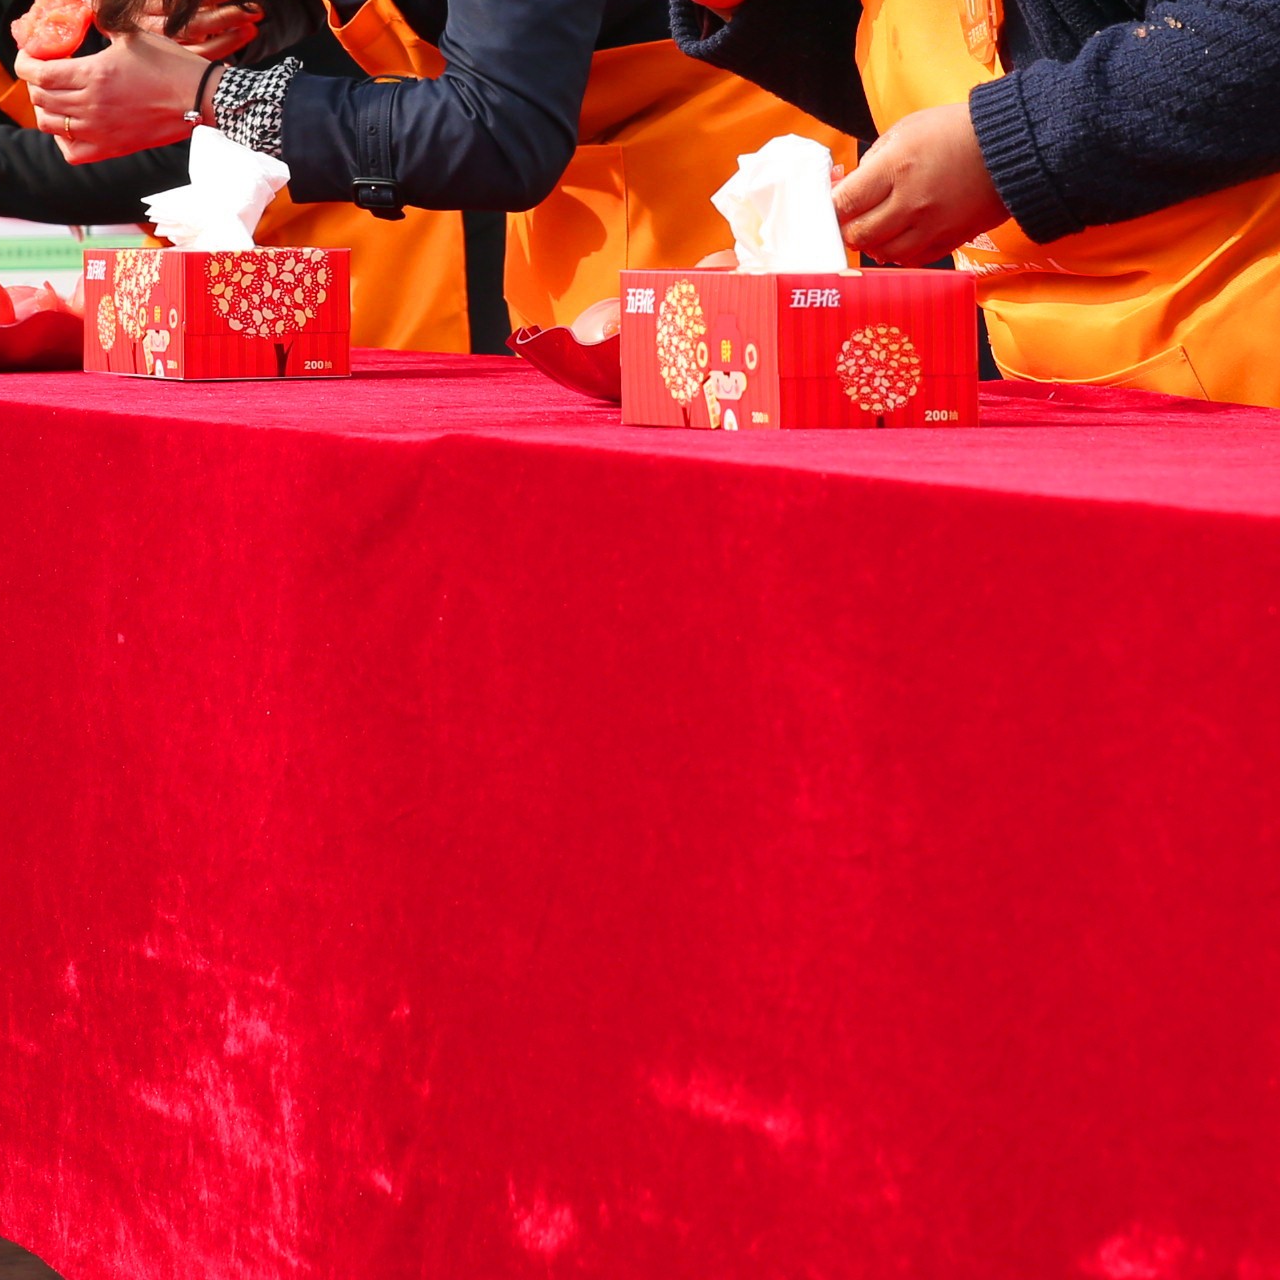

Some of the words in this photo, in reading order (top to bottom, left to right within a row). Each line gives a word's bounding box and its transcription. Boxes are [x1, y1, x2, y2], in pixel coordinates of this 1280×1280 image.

[625, 288, 655, 314] 五月花
[789, 288, 841, 308] 五月花
